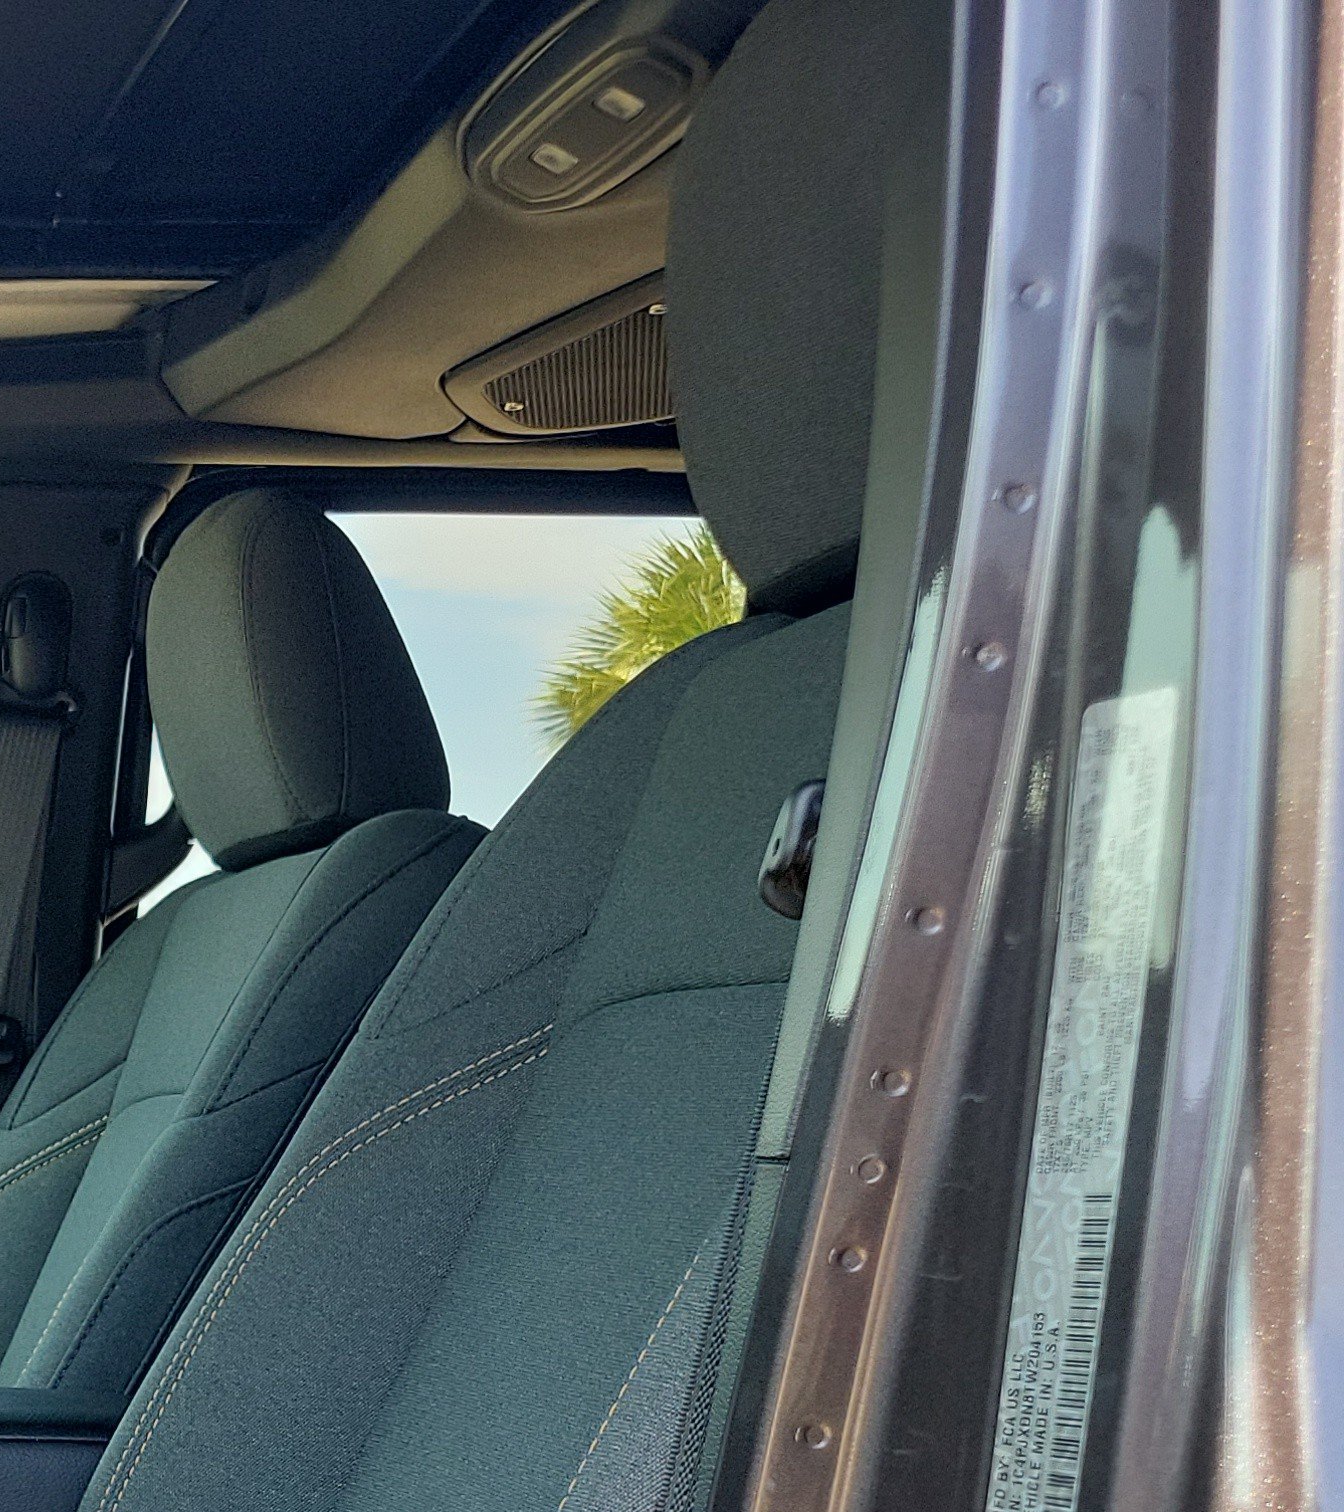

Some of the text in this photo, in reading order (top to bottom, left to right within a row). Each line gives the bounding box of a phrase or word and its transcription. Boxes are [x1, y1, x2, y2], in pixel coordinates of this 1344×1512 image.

[1041, 1320, 1060, 1370] U.S.A.
[1009, 1353, 1023, 1381] LLC
[1005, 1387, 1019, 1409] US
[1011, 1312, 1045, 1486] 1C4PJXDN8TW204153
[1038, 1379, 1052, 1401] IN:
[1000, 1416, 1015, 1446] FCA
[1031, 1407, 1049, 1454] MADE
[996, 1455, 1009, 1481] BY:
